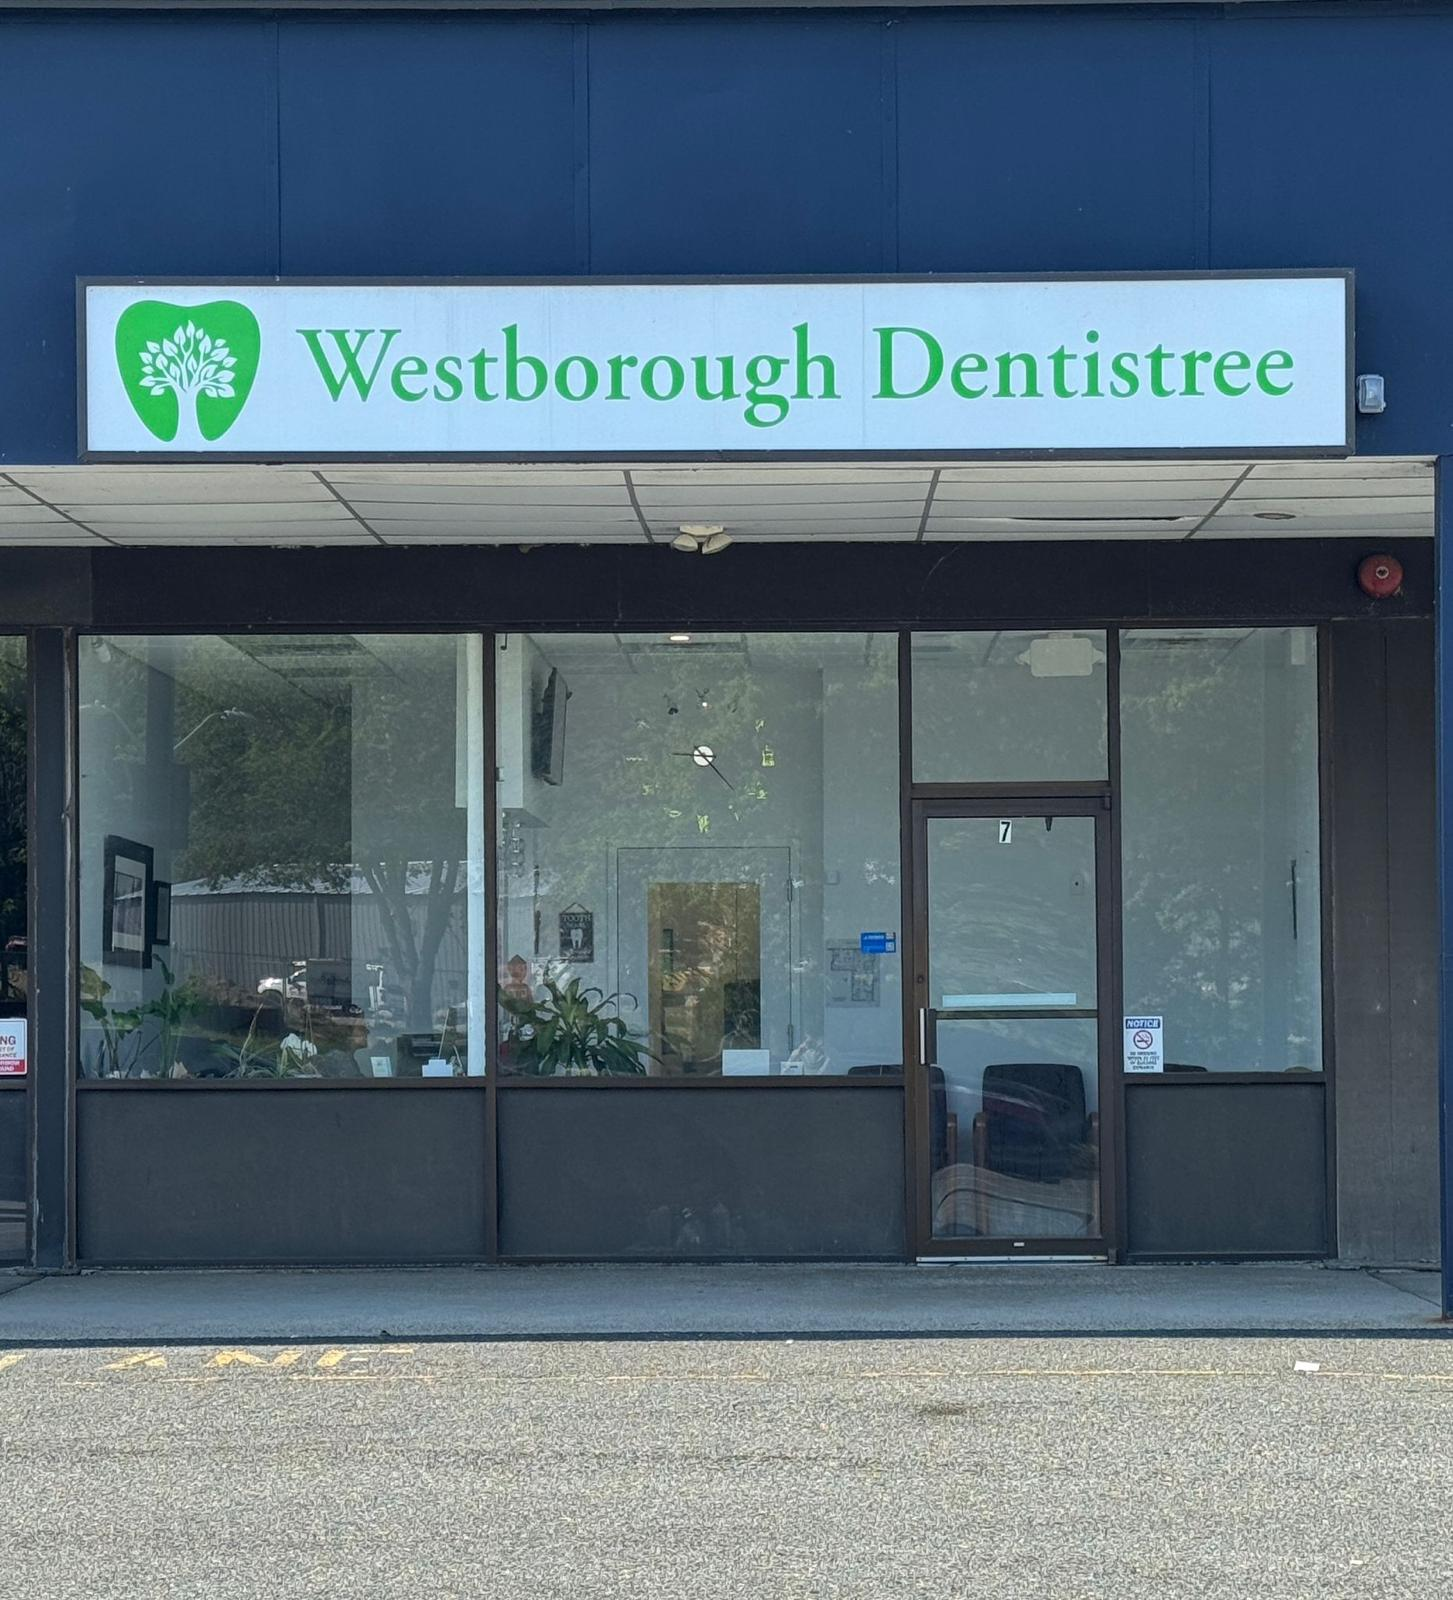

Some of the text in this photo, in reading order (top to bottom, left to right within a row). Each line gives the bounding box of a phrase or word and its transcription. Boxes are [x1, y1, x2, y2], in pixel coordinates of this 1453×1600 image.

[296, 322, 1294, 429] Westborough Dentistree
[1000, 821, 1011, 842] 7
[1126, 1019, 1159, 1028] NOTICE
